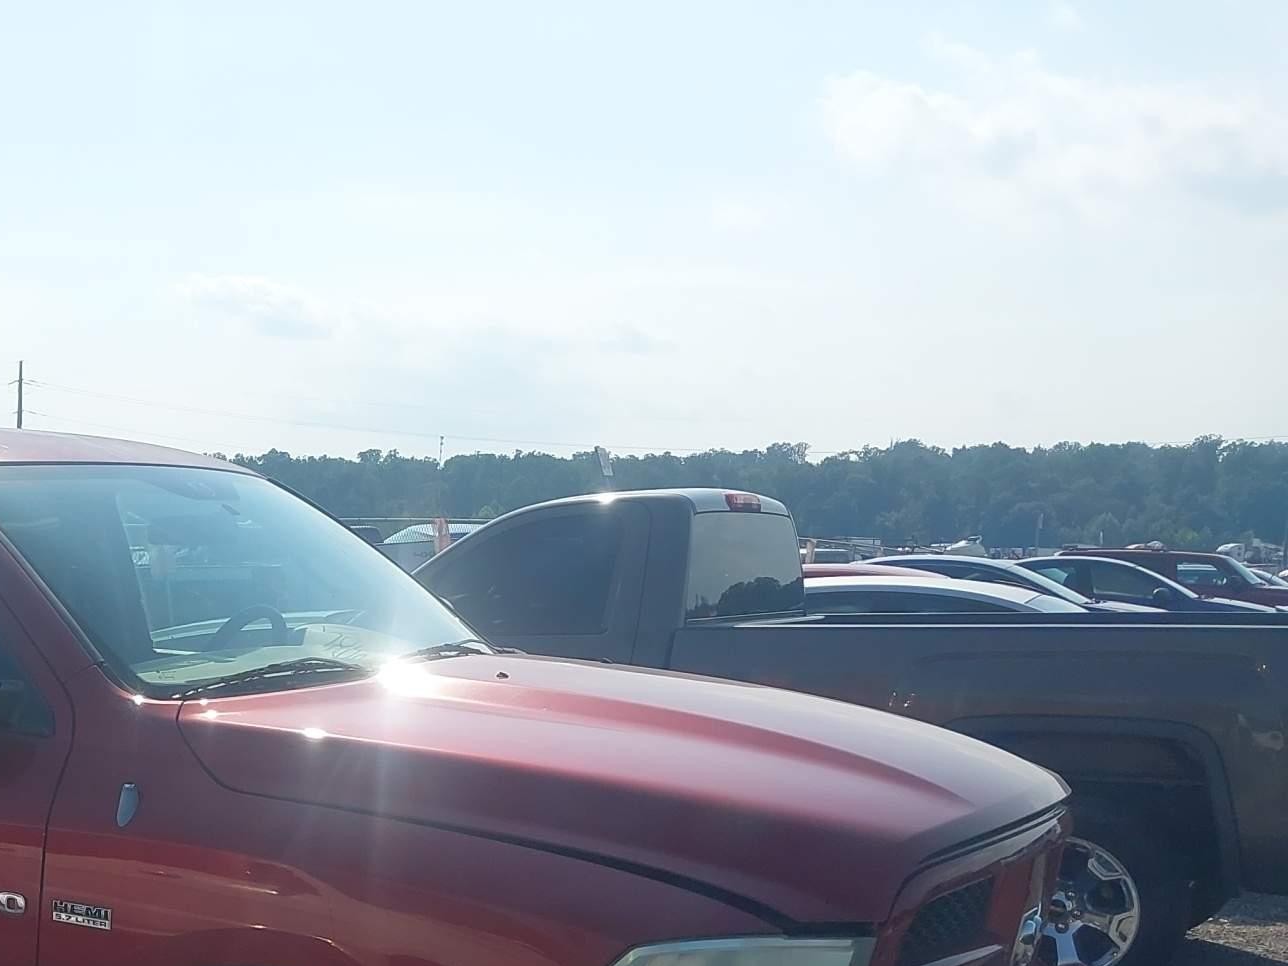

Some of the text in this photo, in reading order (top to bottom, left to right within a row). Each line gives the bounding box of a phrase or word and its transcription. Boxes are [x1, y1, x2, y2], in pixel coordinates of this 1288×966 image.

[53, 900, 110, 921] HEMI
[55, 913, 107, 928] 5.7 LITER
